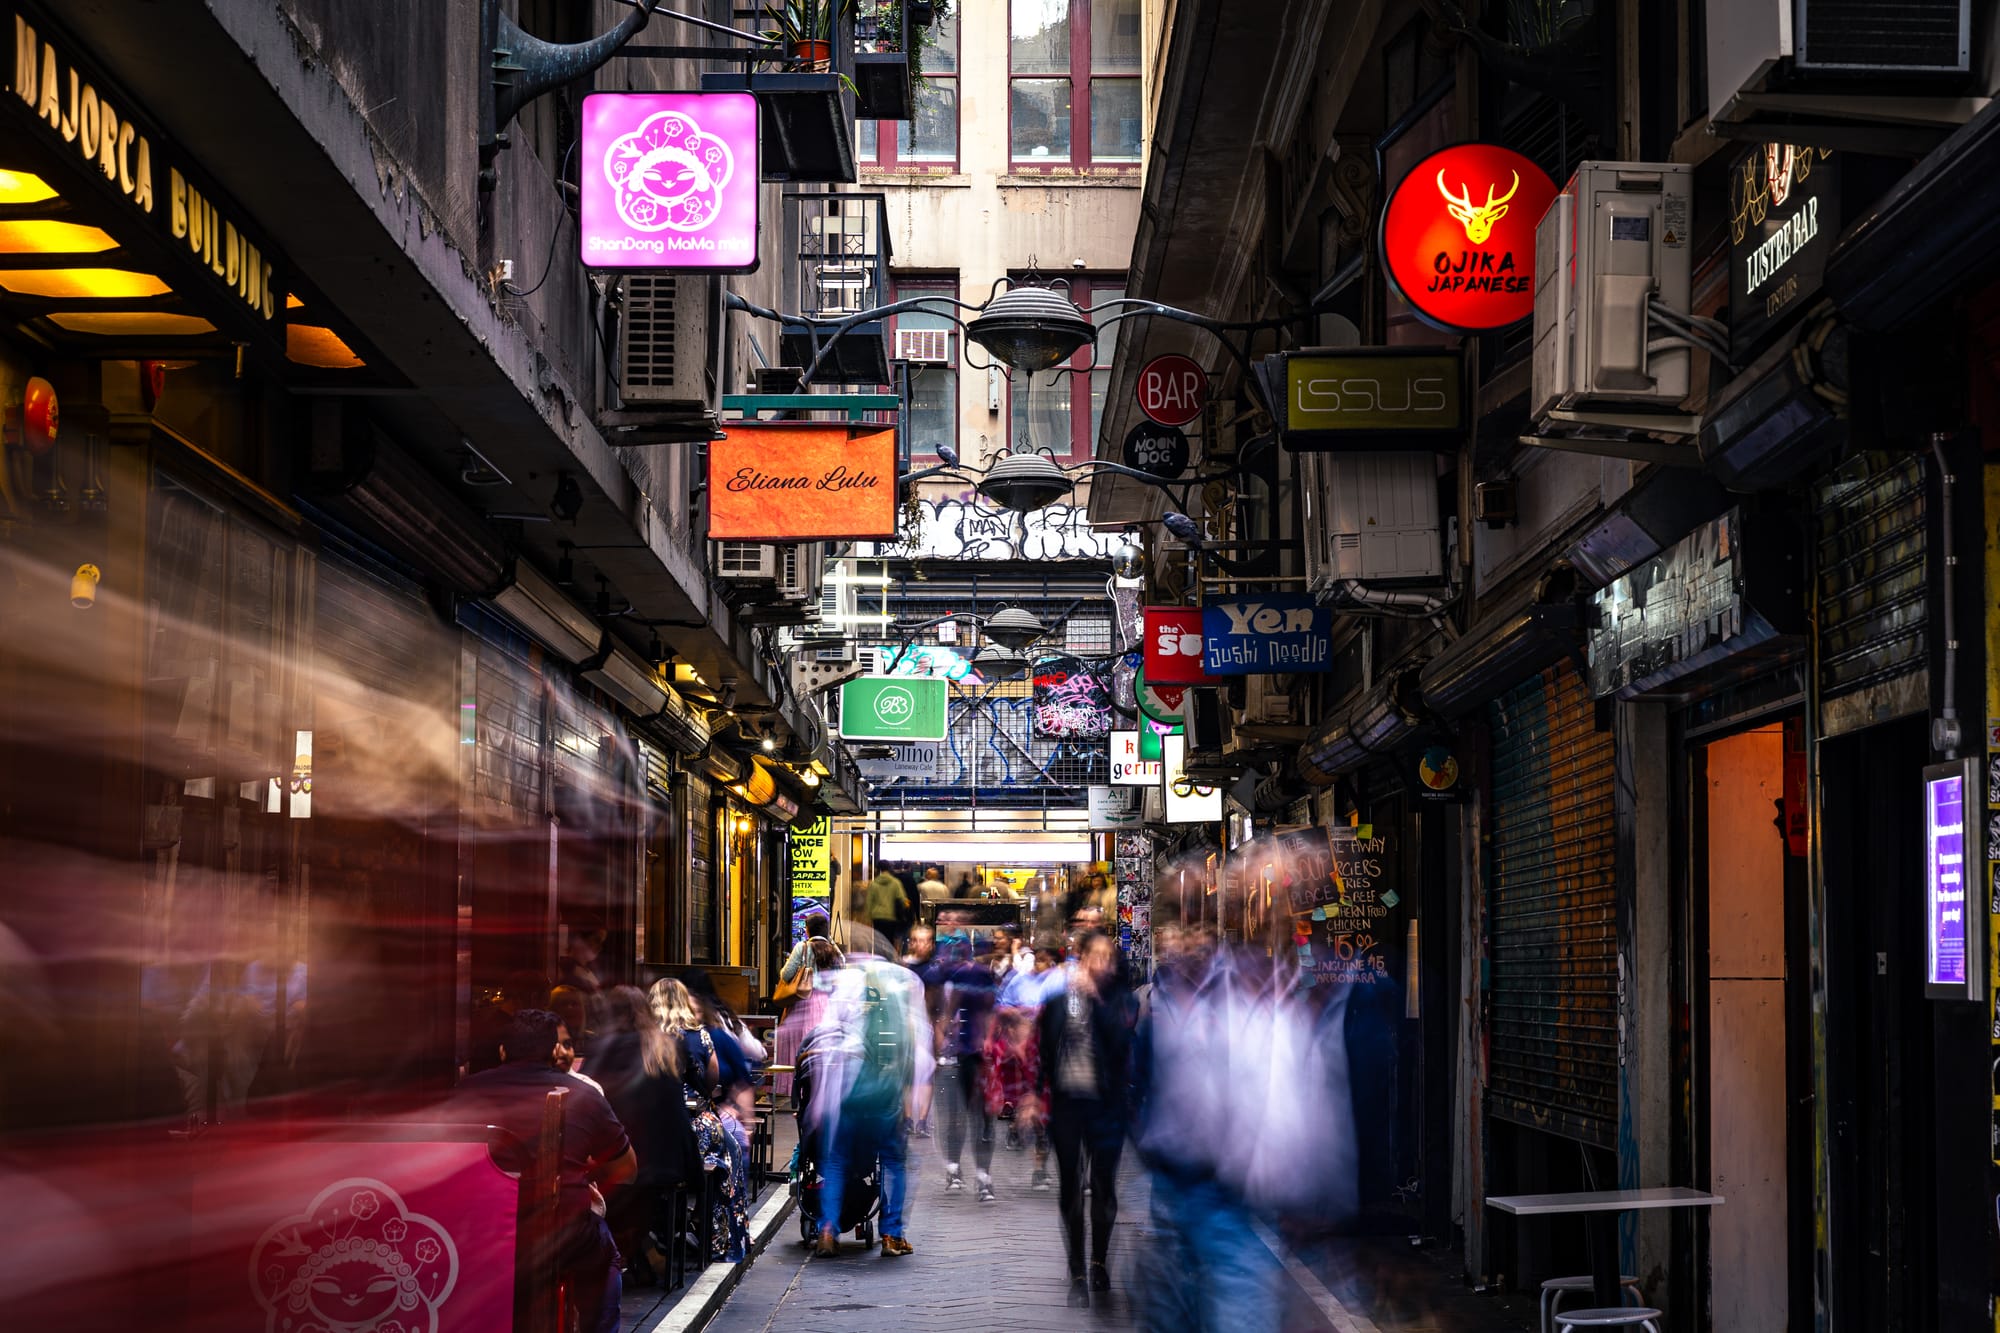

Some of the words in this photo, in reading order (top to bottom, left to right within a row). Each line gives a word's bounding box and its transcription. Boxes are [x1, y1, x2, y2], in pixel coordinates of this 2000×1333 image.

[16, 13, 152, 213] MAJORCA
[171, 166, 274, 320] BUILDING
[588, 236, 664, 254] ShanDong
[668, 236, 714, 250] MaMa
[718, 236, 749, 250] mini
[1746, 220, 1791, 295] LUSTRE
[1792, 196, 1818, 255] BAR
[1434, 251, 1515, 274] OJIKA
[1427, 275, 1530, 294] JAPANESE
[1147, 371, 1199, 410] BAR
[1134, 437, 1177, 453] MOON
[1138, 452, 1171, 466] DOG
[726, 467, 813, 492] Eliana
[816, 465, 879, 491] Lulu
[1158, 624, 1179, 634] the
[1218, 603, 1314, 635] Yen
[1208, 637, 1259, 668] Sushi
[866, 745, 934, 764] olino
[1326, 918, 1371, 932] CHICKEN
